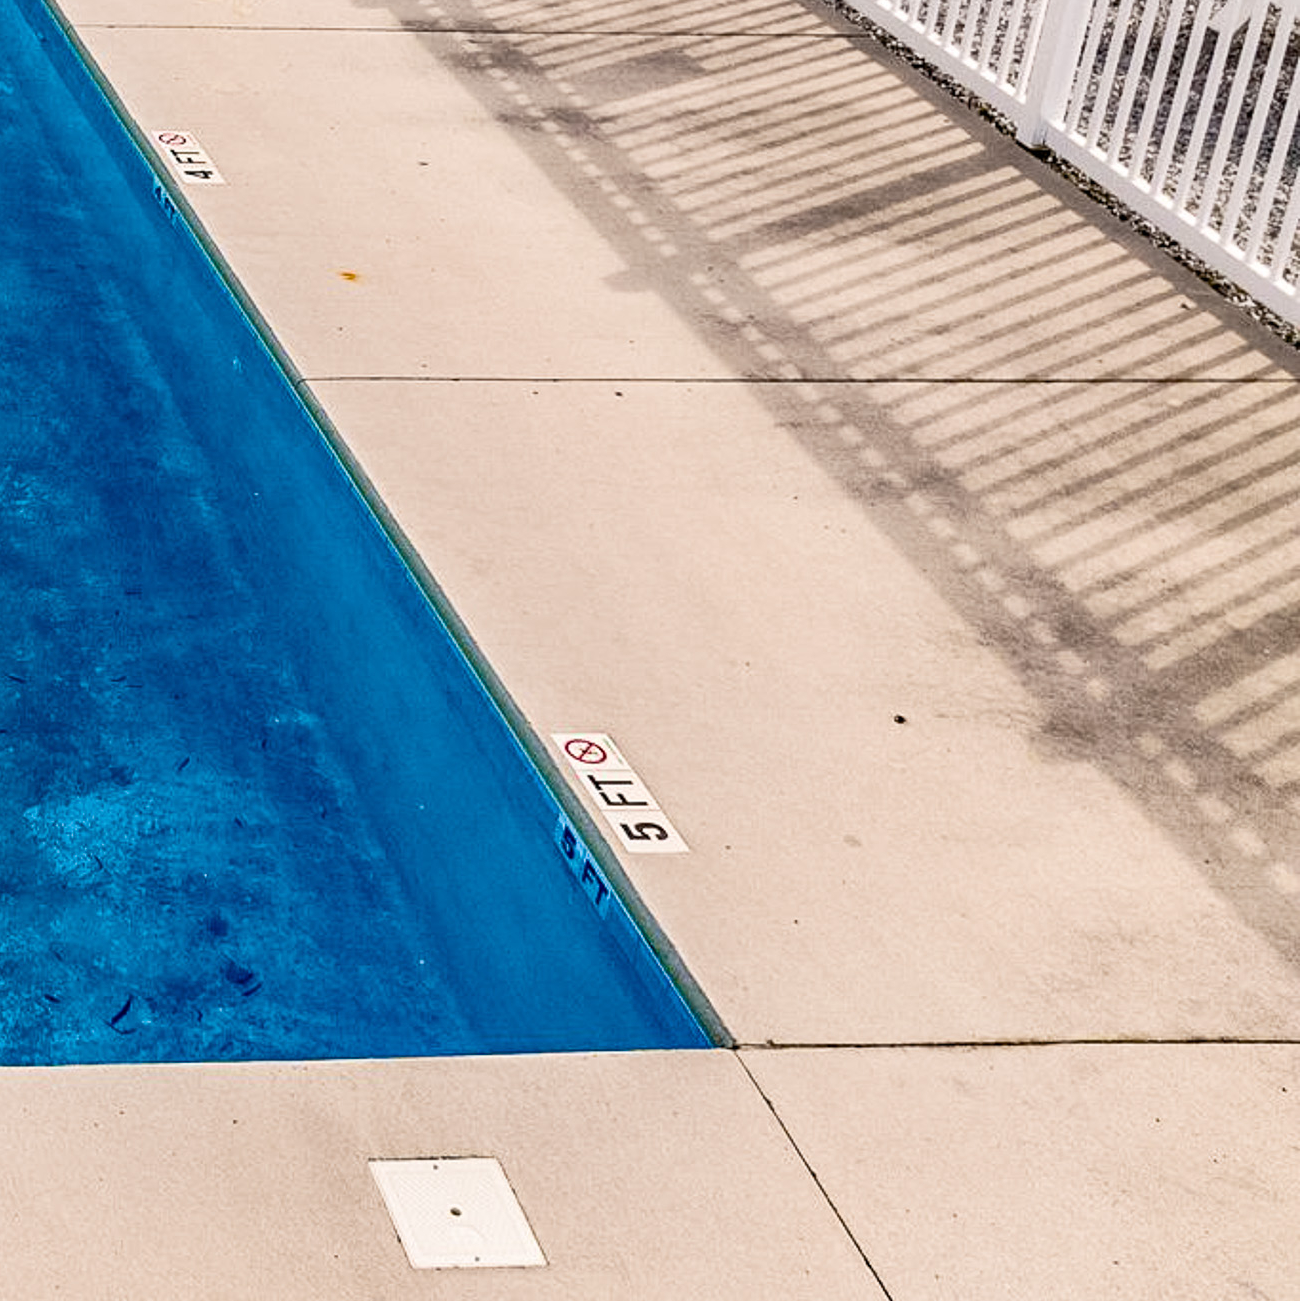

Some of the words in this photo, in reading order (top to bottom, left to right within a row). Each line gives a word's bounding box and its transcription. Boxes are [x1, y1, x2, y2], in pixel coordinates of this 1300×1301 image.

[170, 149, 207, 164] FT
[184, 170, 214, 179] 4
[587, 774, 649, 807] FT
[619, 822, 669, 841] 5
[582, 860, 609, 905] FT
